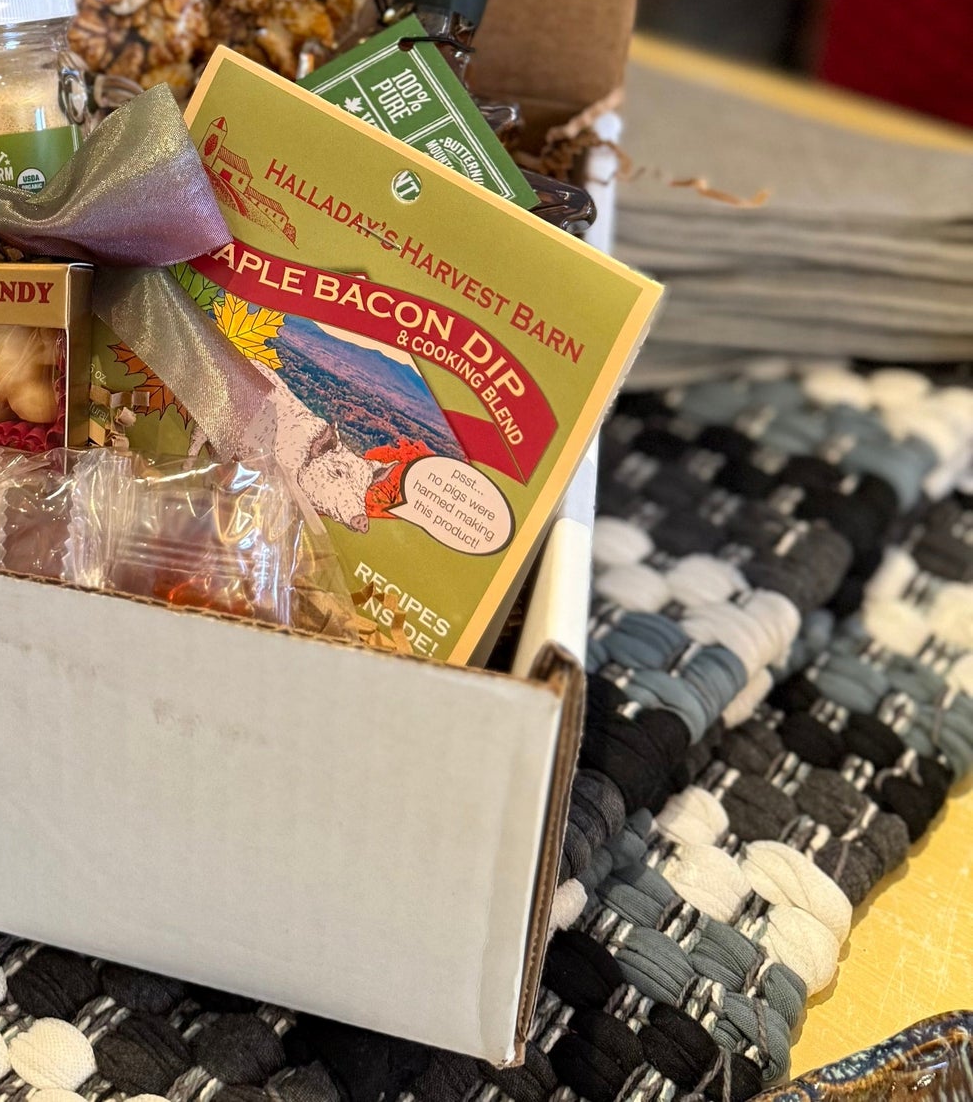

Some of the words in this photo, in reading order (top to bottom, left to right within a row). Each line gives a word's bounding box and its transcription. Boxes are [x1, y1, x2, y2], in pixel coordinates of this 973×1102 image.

[371, 78, 413, 125] PURE
[392, 68, 432, 113] 100%
[22, 173, 41, 183] USDA
[211, 242, 304, 295] APLE
[313, 274, 457, 342] BACON
[461, 330, 526, 398] DIP
[399, 237, 511, 318] HARVEST
[509, 301, 586, 365] BARN
[397, 330, 409, 347] &
[411, 336, 486, 388] COOKING
[481, 385, 524, 445] BLEND
[427, 472, 443, 486] no
[442, 482, 468, 504] pigs
[469, 498, 496, 522] were
[450, 469, 484, 496] psst...
[413, 479, 456, 514] harmed
[454, 508, 496, 543] making
[413, 498, 433, 519] this
[432, 514, 481, 550] product!
[360, 597, 439, 658] NSDE!
